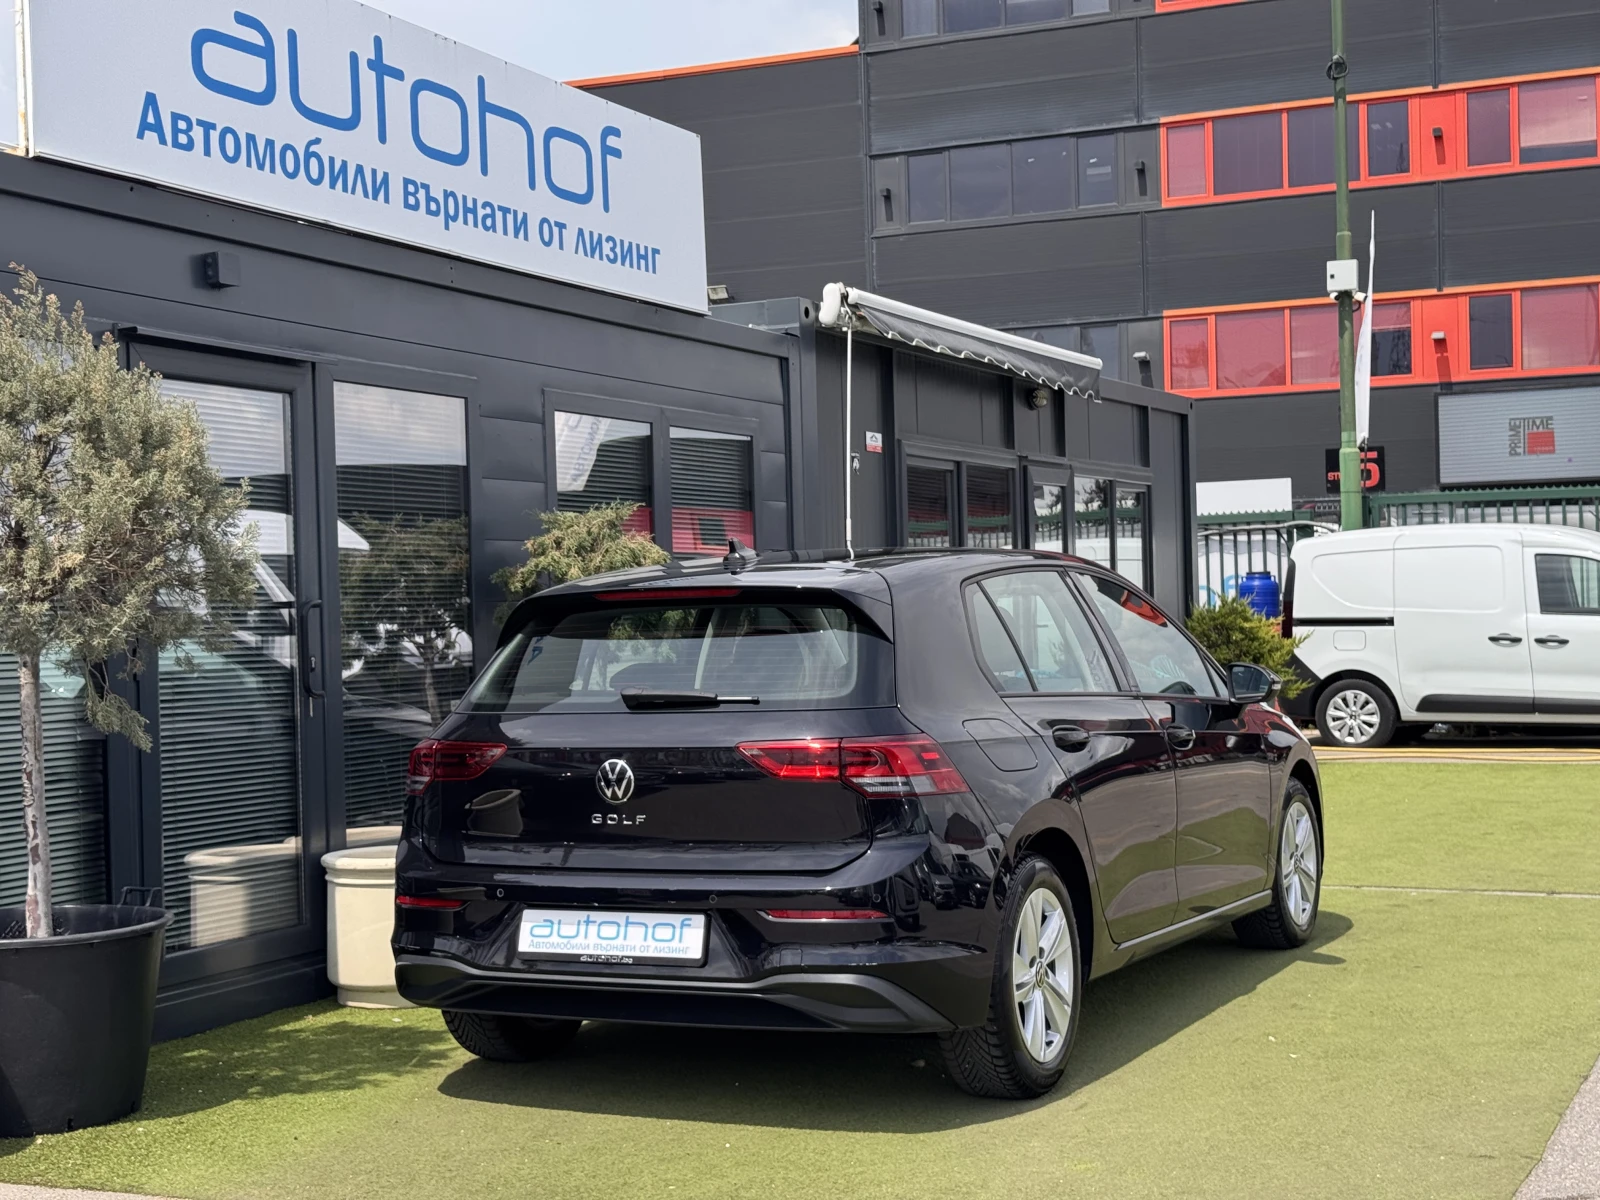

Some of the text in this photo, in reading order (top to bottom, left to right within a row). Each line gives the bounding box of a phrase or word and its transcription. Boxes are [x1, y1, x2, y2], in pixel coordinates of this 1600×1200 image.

[190, 10, 623, 214] autohof
[136, 90, 661, 274] Автомобили върнати от лизинг
[1508, 417, 1522, 456] PRIME
[591, 813, 647, 825] GOLF
[529, 913, 692, 944] autohof
[528, 939, 690, 955] Автомобили върнати от лизинг
